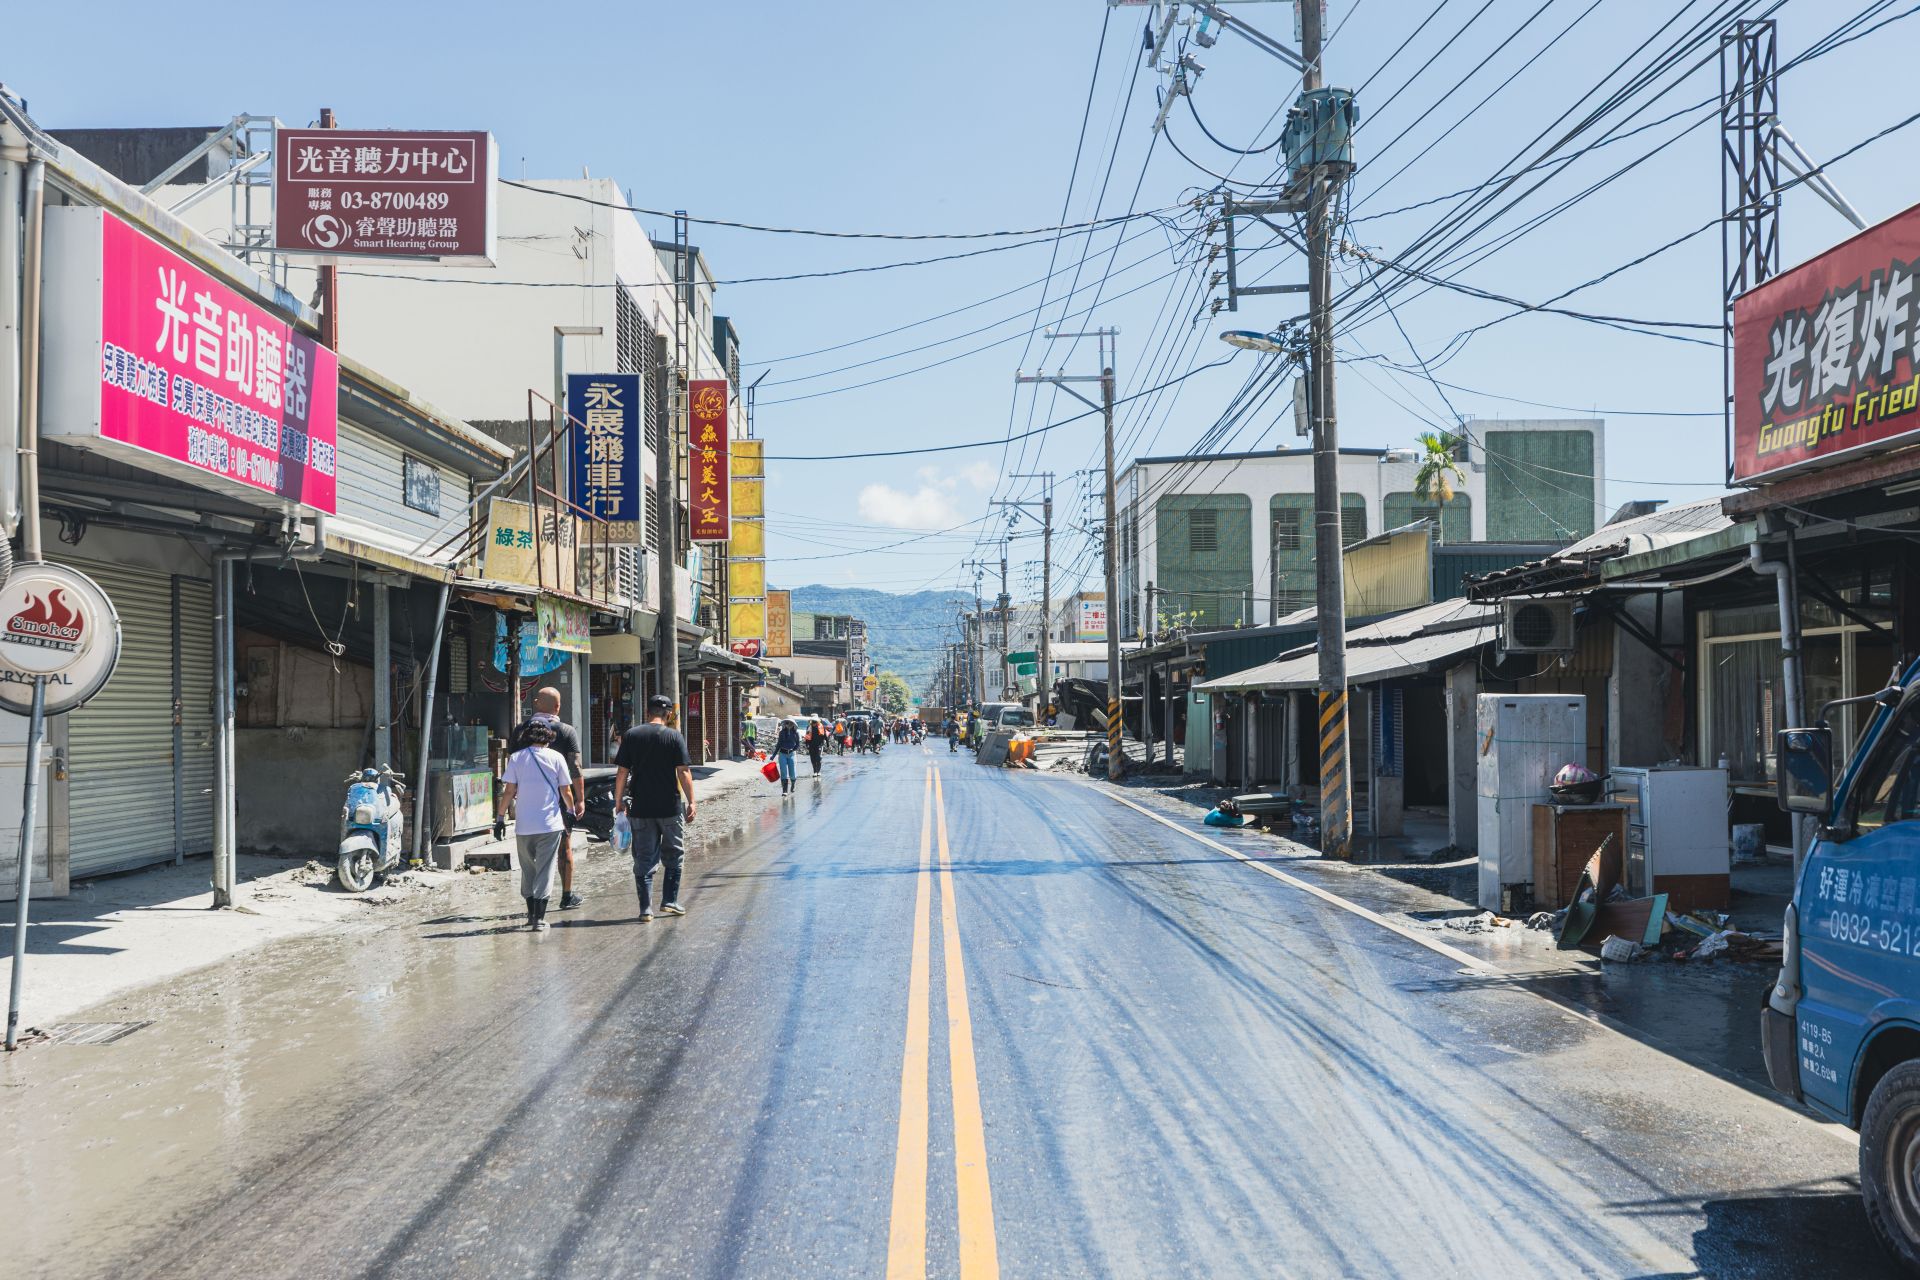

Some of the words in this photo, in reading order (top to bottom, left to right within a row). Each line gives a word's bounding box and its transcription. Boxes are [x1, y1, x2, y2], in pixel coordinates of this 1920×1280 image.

[297, 146, 468, 175] 光音聽力中心
[308, 188, 332, 198] 服務
[340, 192, 449, 209] 03-8700489
[355, 217, 458, 238] 睿聲助聽器
[353, 239, 384, 248] Smart
[386, 239, 426, 250] Hearing
[428, 240, 459, 250] Group
[156, 266, 307, 421] 光音助聽器
[1758, 403, 1845, 455] Guangfu
[1852, 374, 1920, 427] Fried
[584, 383, 624, 515] 永展機車行
[495, 527, 534, 550] 綠茶
[12, 616, 80, 639] Smoker
[1819, 866, 1920, 914] 好運冷凍空調
